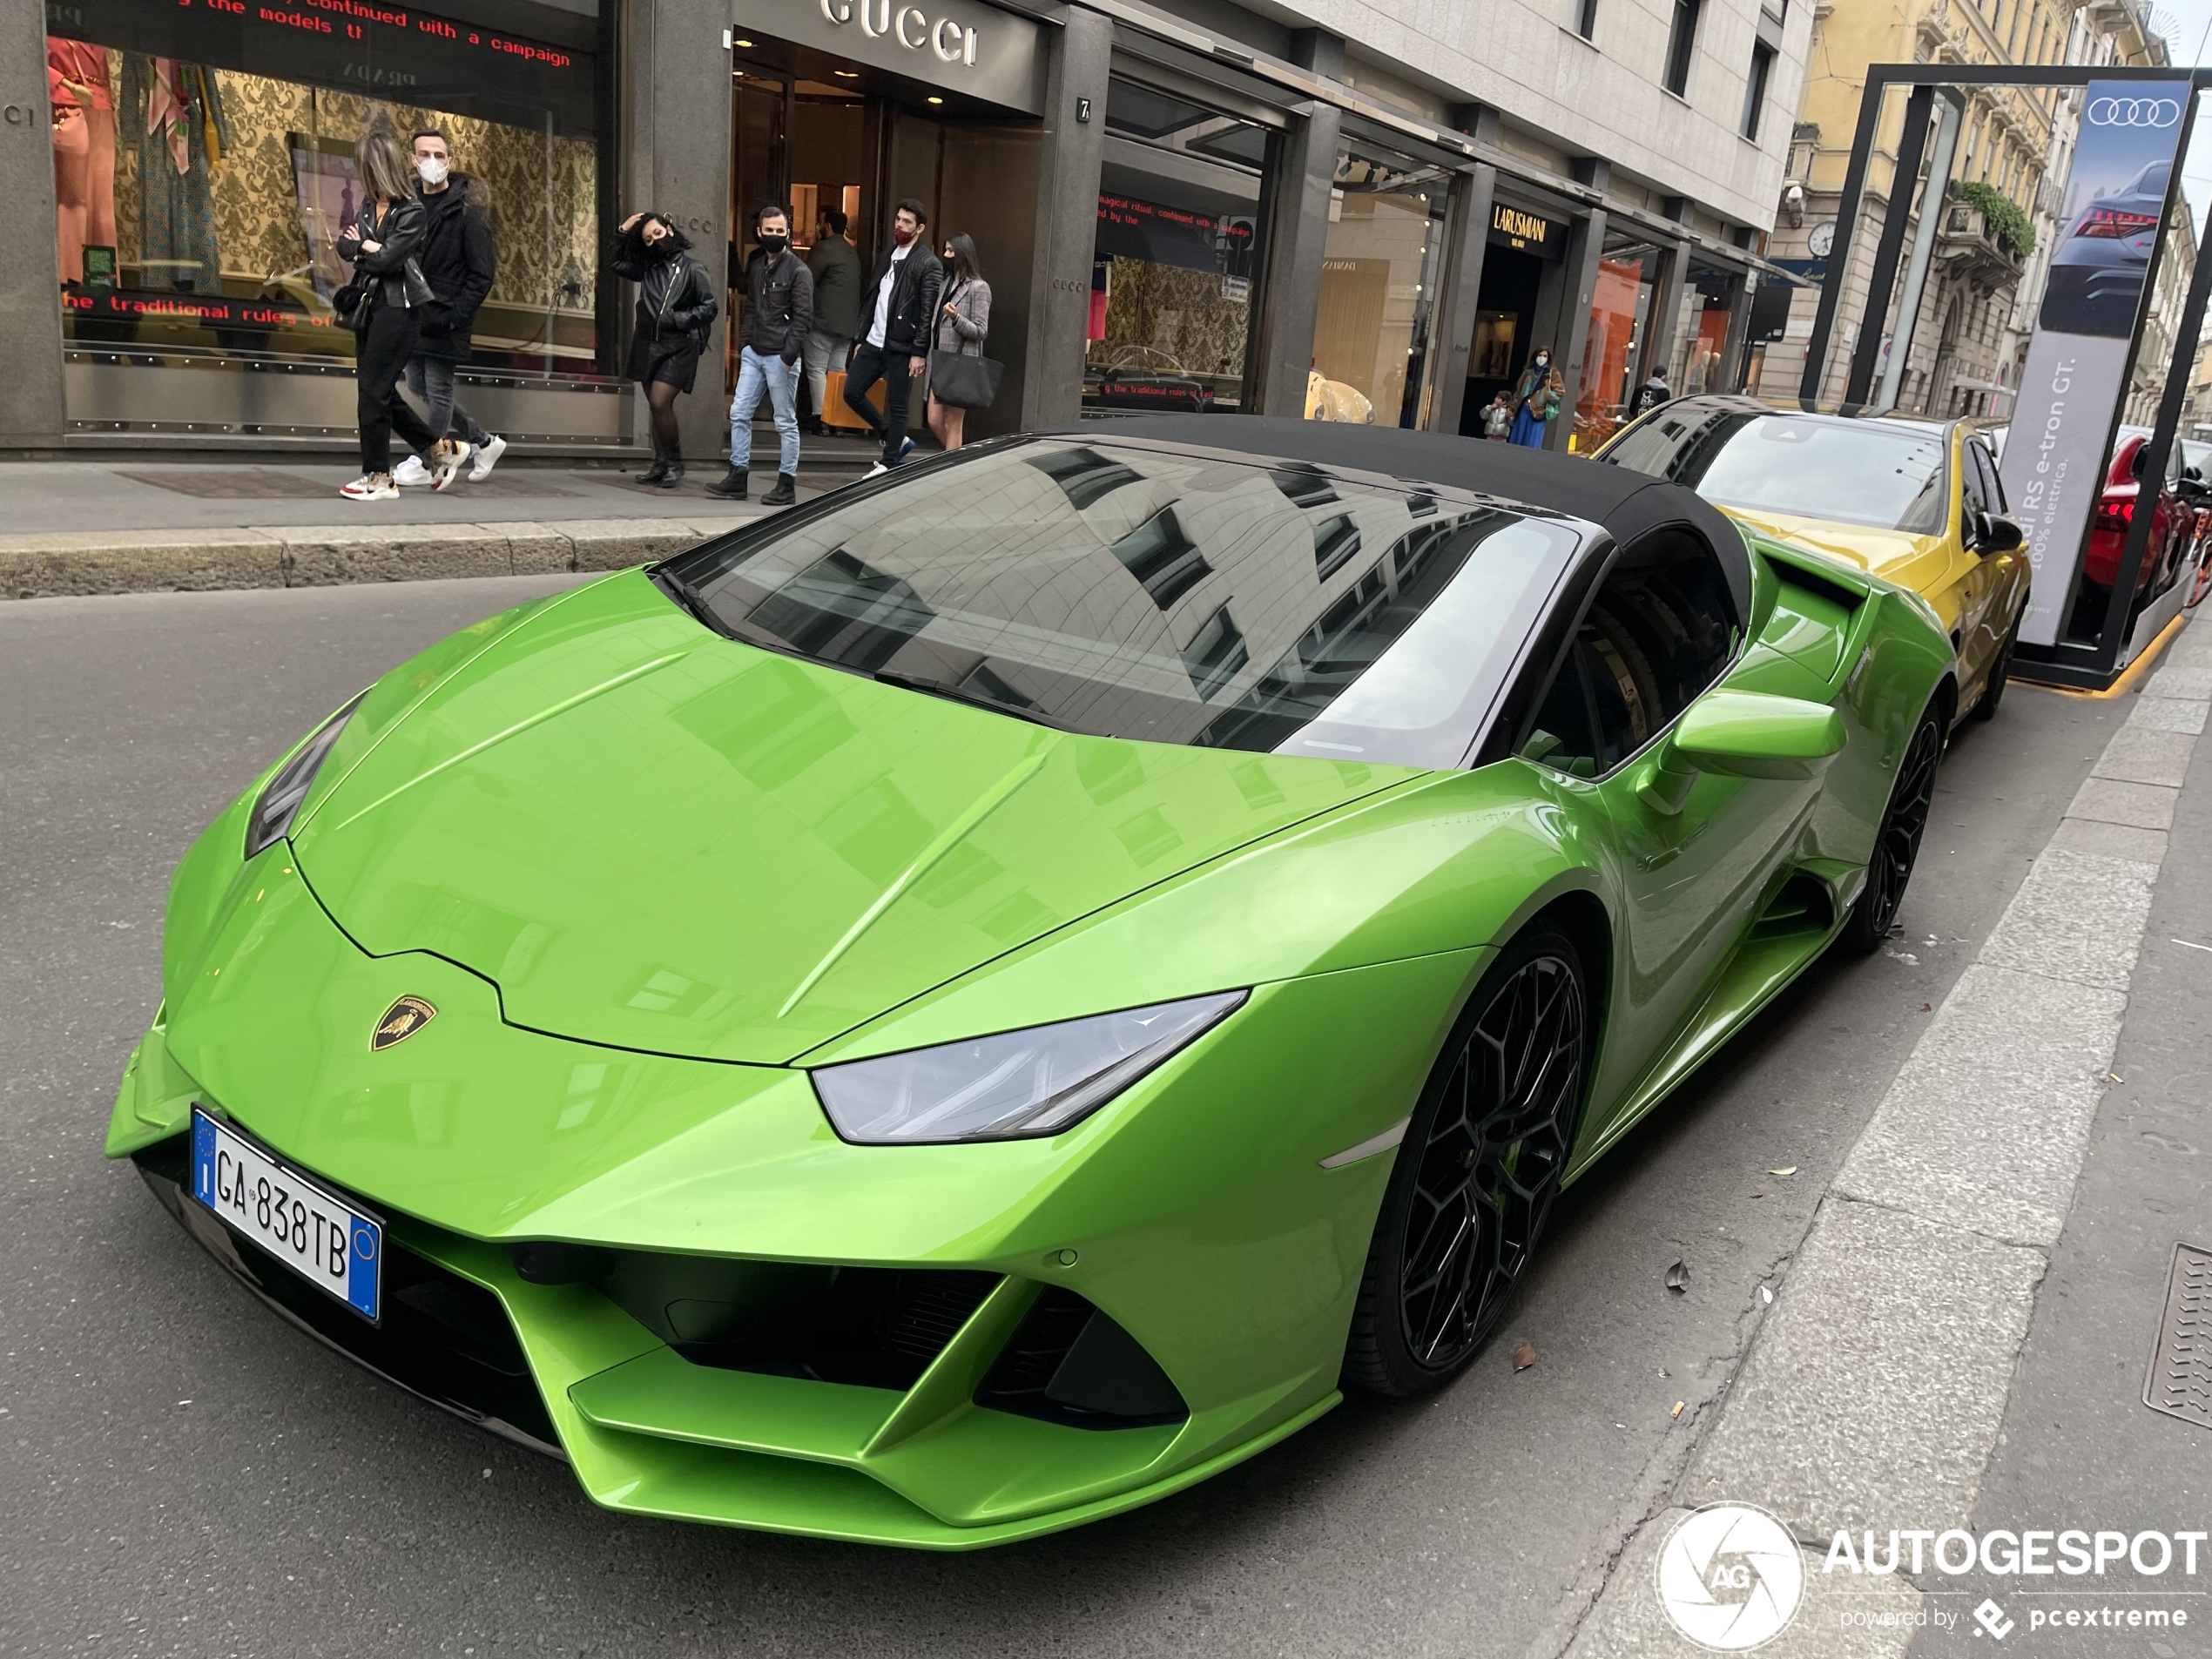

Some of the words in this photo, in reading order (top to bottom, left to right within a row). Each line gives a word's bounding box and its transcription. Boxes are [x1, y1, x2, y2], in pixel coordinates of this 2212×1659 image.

[260, 7, 332, 33] models
[820, 0, 978, 67] GUCCI
[469, 33, 480, 44] a
[490, 38, 570, 67] campaign
[1109, 212, 1121, 224] by
[1124, 215, 1139, 226] the
[1158, 209, 1194, 224] continued
[1494, 205, 1547, 243] LARUSMIANI
[1053, 278, 1086, 293] GUCCI
[110, 296, 229, 320] traditional
[241, 308, 297, 326] rules
[1114, 384, 1126, 393] the
[1130, 385, 1166, 395] traditional
[2051, 358, 2077, 395] GT.
[2036, 401, 2065, 474] e-tron
[2022, 480, 2045, 510] RS
[2031, 528, 2051, 571] 100%
[2043, 457, 2069, 524] elettrica.
[2019, 516, 2036, 543] di
